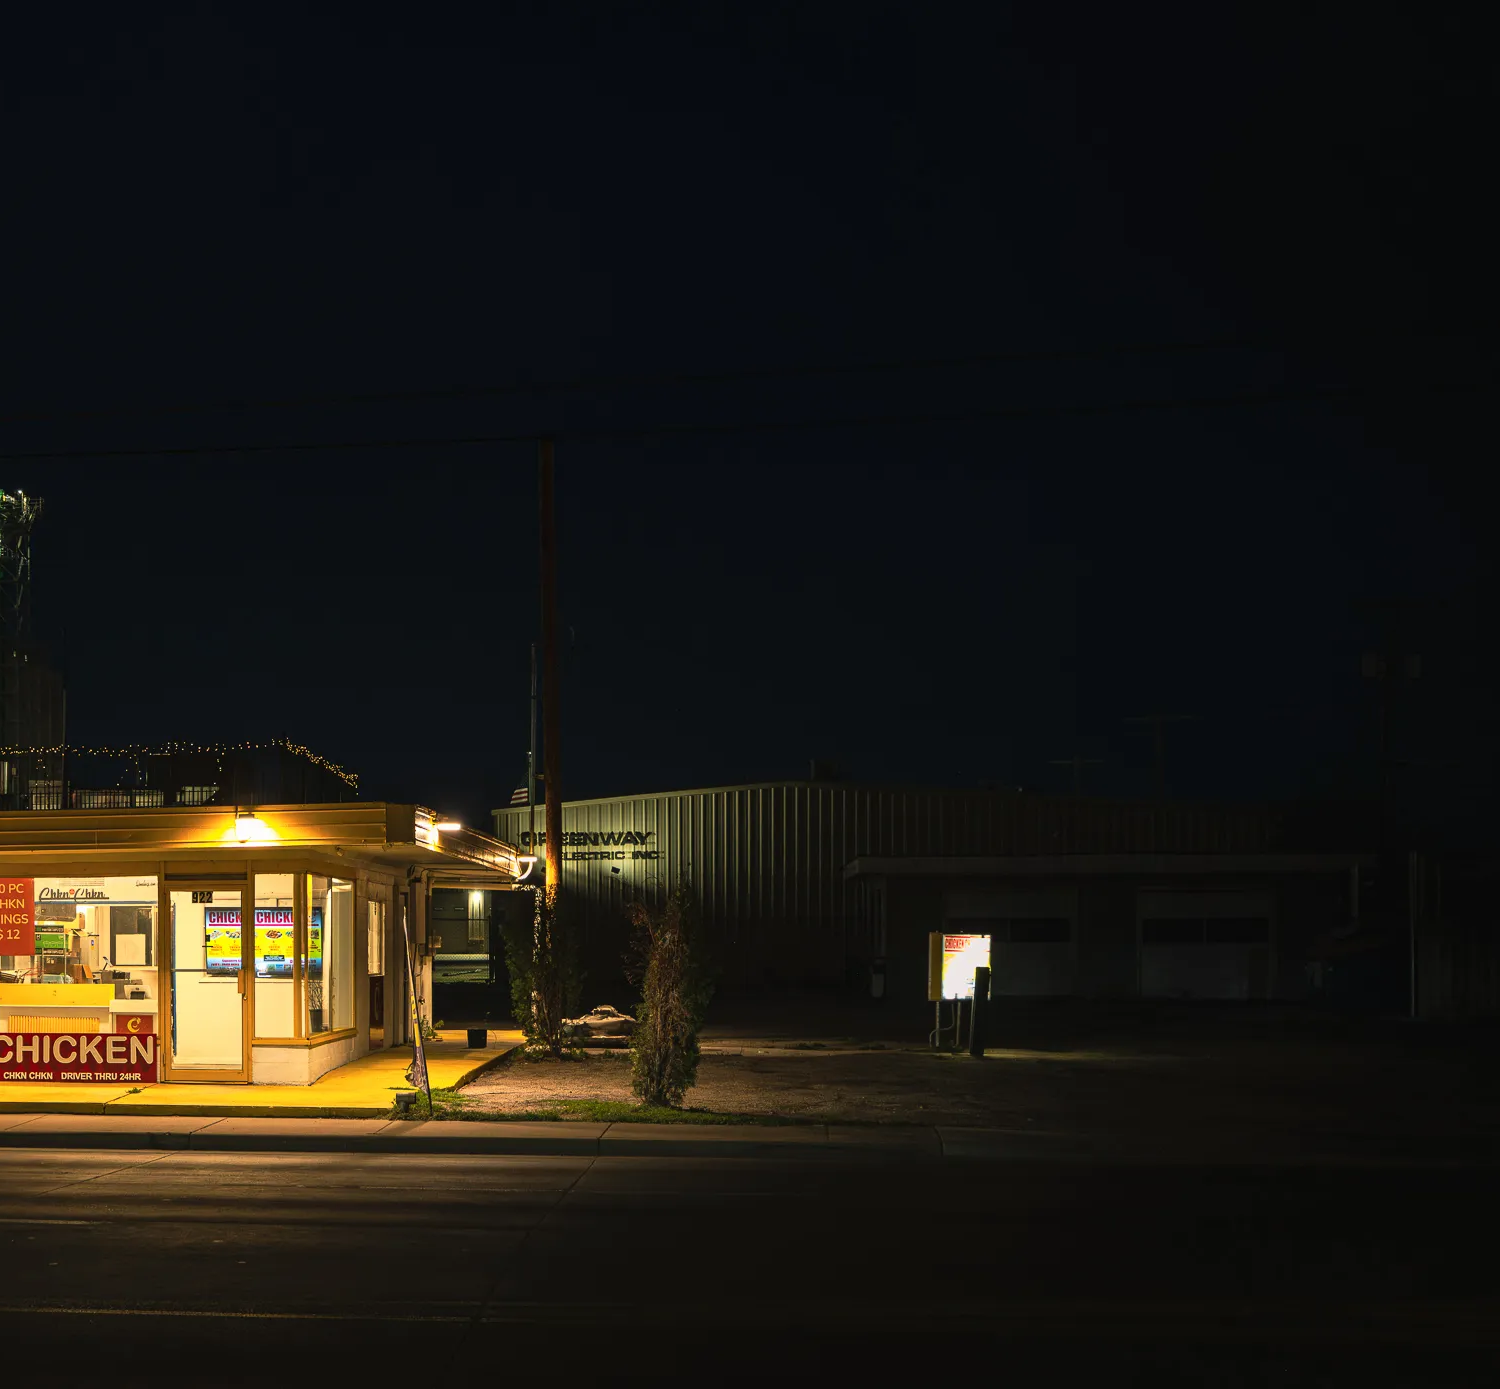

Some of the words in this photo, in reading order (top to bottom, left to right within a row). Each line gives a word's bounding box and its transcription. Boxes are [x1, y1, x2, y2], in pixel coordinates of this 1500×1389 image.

[562, 851, 626, 860] LECTRIC
[8, 883, 25, 894] PC
[192, 891, 213, 903] 922
[3, 1071, 27, 1080] CHKN
[28, 1072, 53, 1080] CHKN
[60, 1072, 93, 1081] DRIVER
[93, 1072, 118, 1081] THRU
[119, 1073, 142, 1081] 24HR
